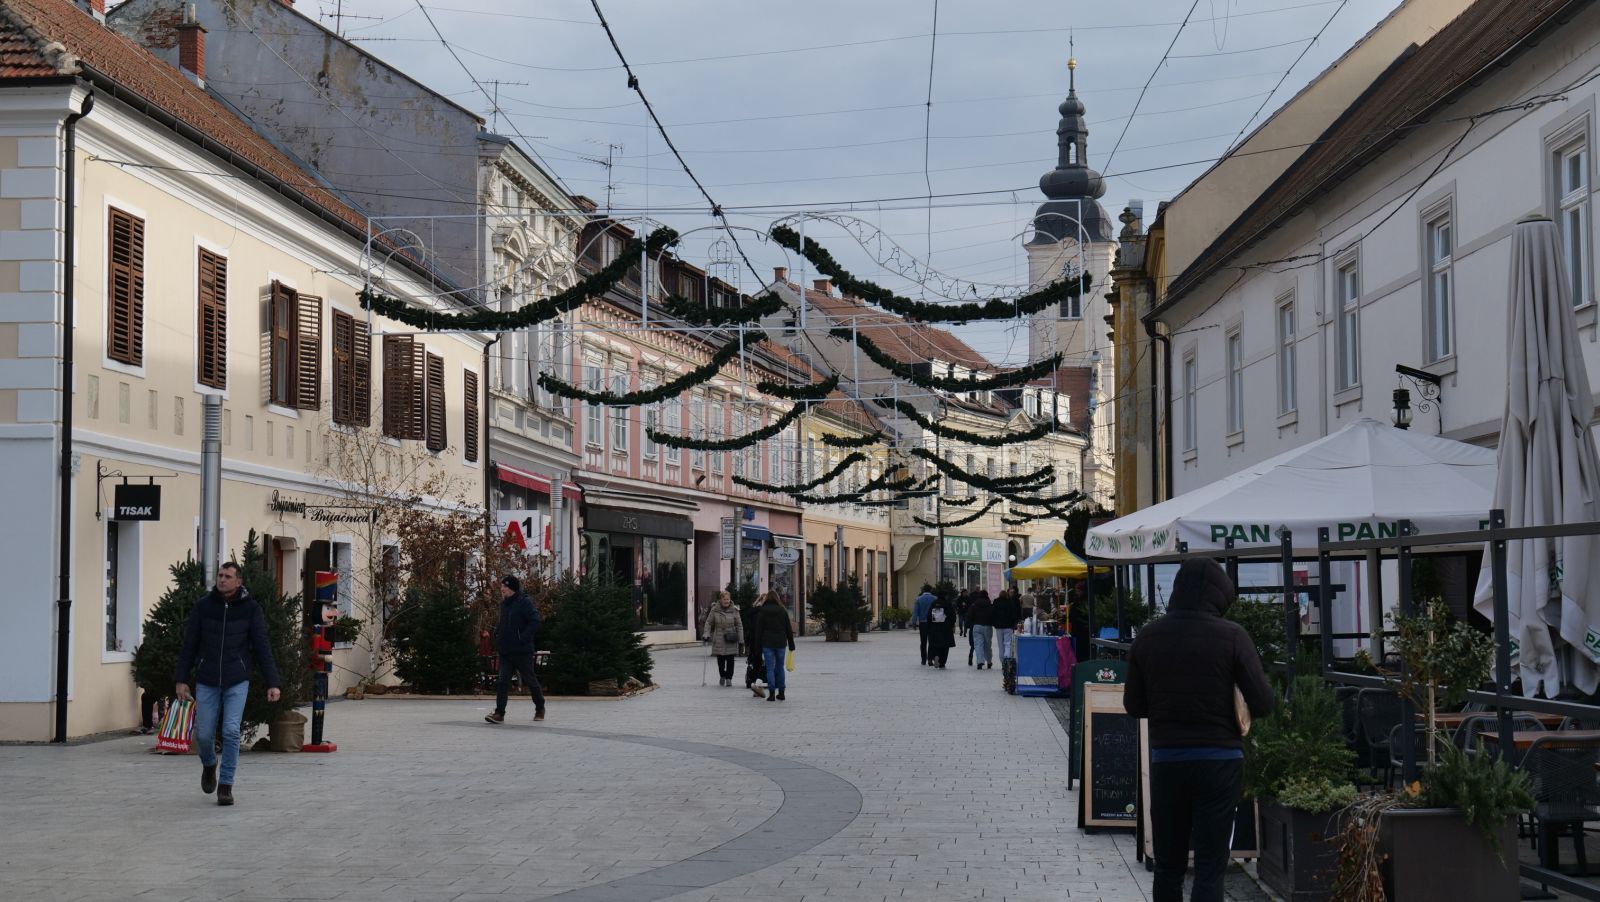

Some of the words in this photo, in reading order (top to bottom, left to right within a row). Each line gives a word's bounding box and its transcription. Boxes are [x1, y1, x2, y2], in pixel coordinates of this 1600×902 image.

[119, 506, 153, 516] TISAK
[500, 516, 532, 550] A1
[1211, 524, 1271, 543] PAN
[1338, 522, 1398, 542] PAN
[944, 538, 979, 556] MODA
